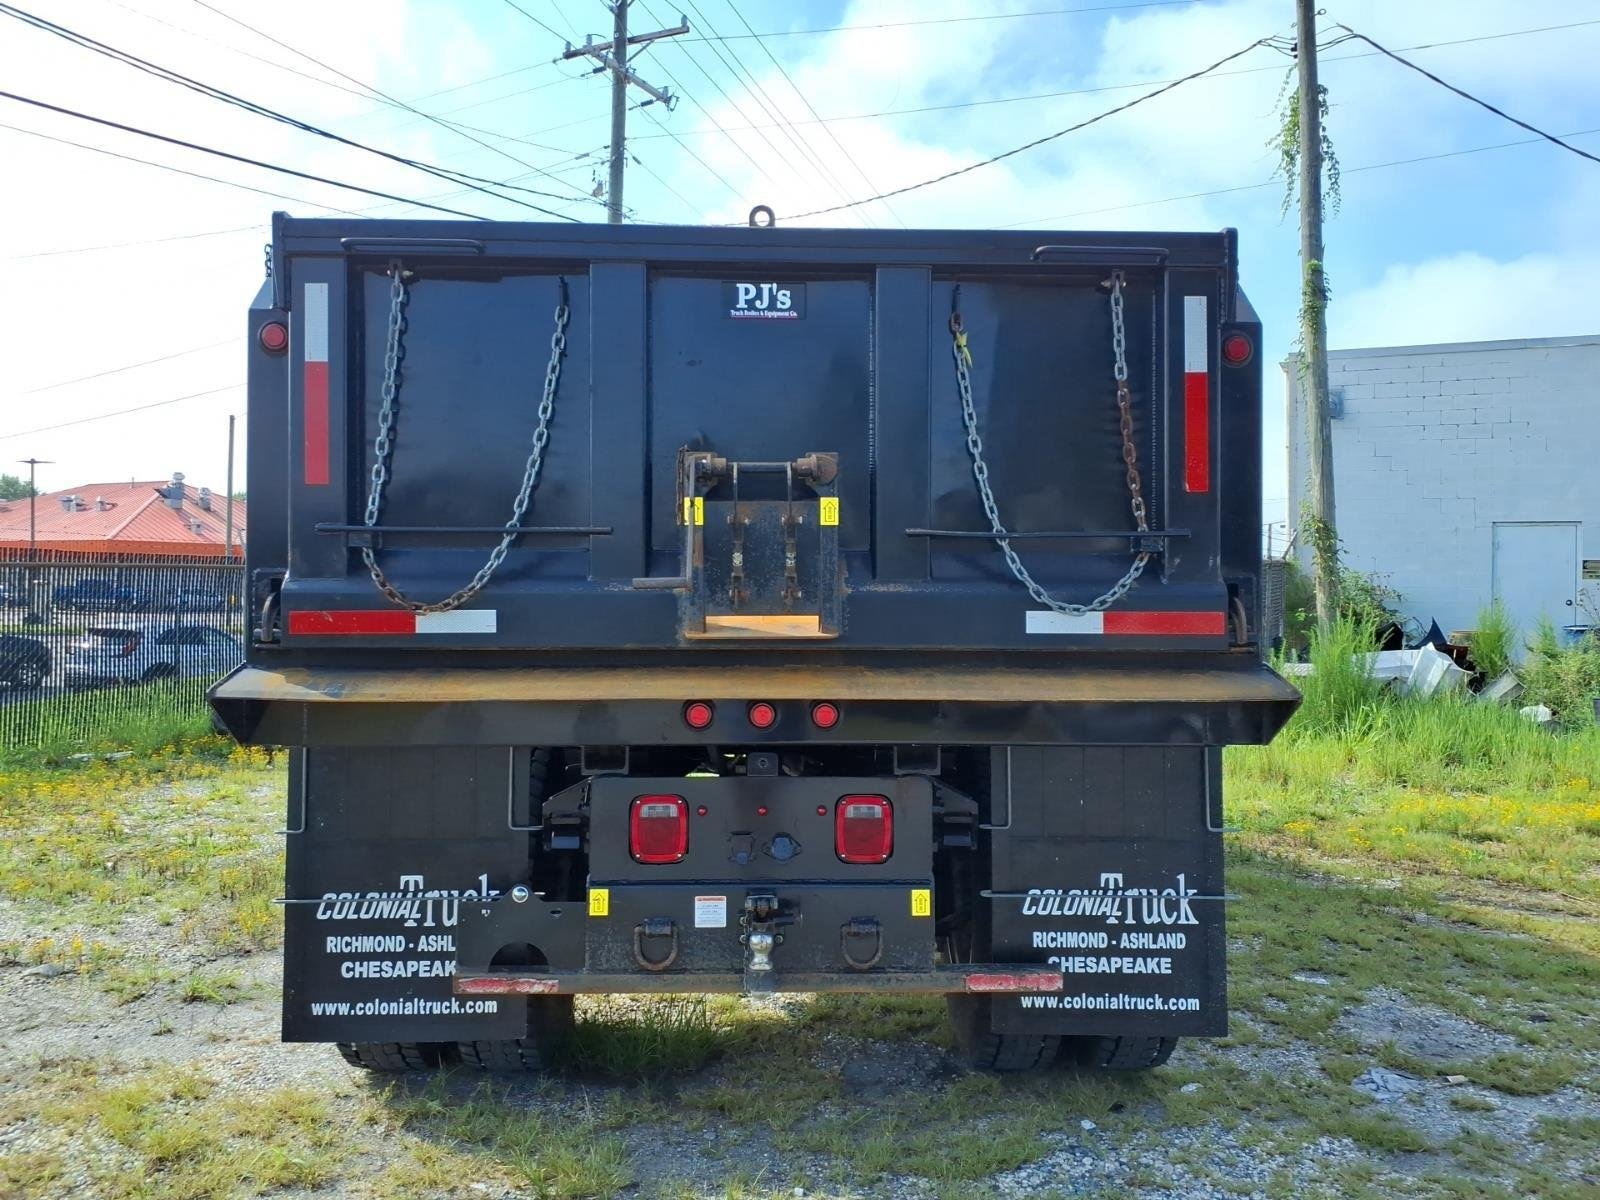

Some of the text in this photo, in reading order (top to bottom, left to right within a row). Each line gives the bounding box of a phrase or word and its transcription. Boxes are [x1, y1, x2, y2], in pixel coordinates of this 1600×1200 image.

[736, 283, 792, 309] PJ's
[317, 892, 422, 921] COLONIAL
[1022, 872, 1200, 925] COLONIAL Truck
[326, 935, 406, 953] RICHMOND
[1033, 932, 1108, 949] RICHMOND
[1120, 932, 1187, 950] ASHLAND
[341, 960, 456, 979] CHESAPEAK
[311, 997, 498, 1016] www.colonialtruck.com
[1021, 993, 1200, 1011] www.colonialtruck.com
